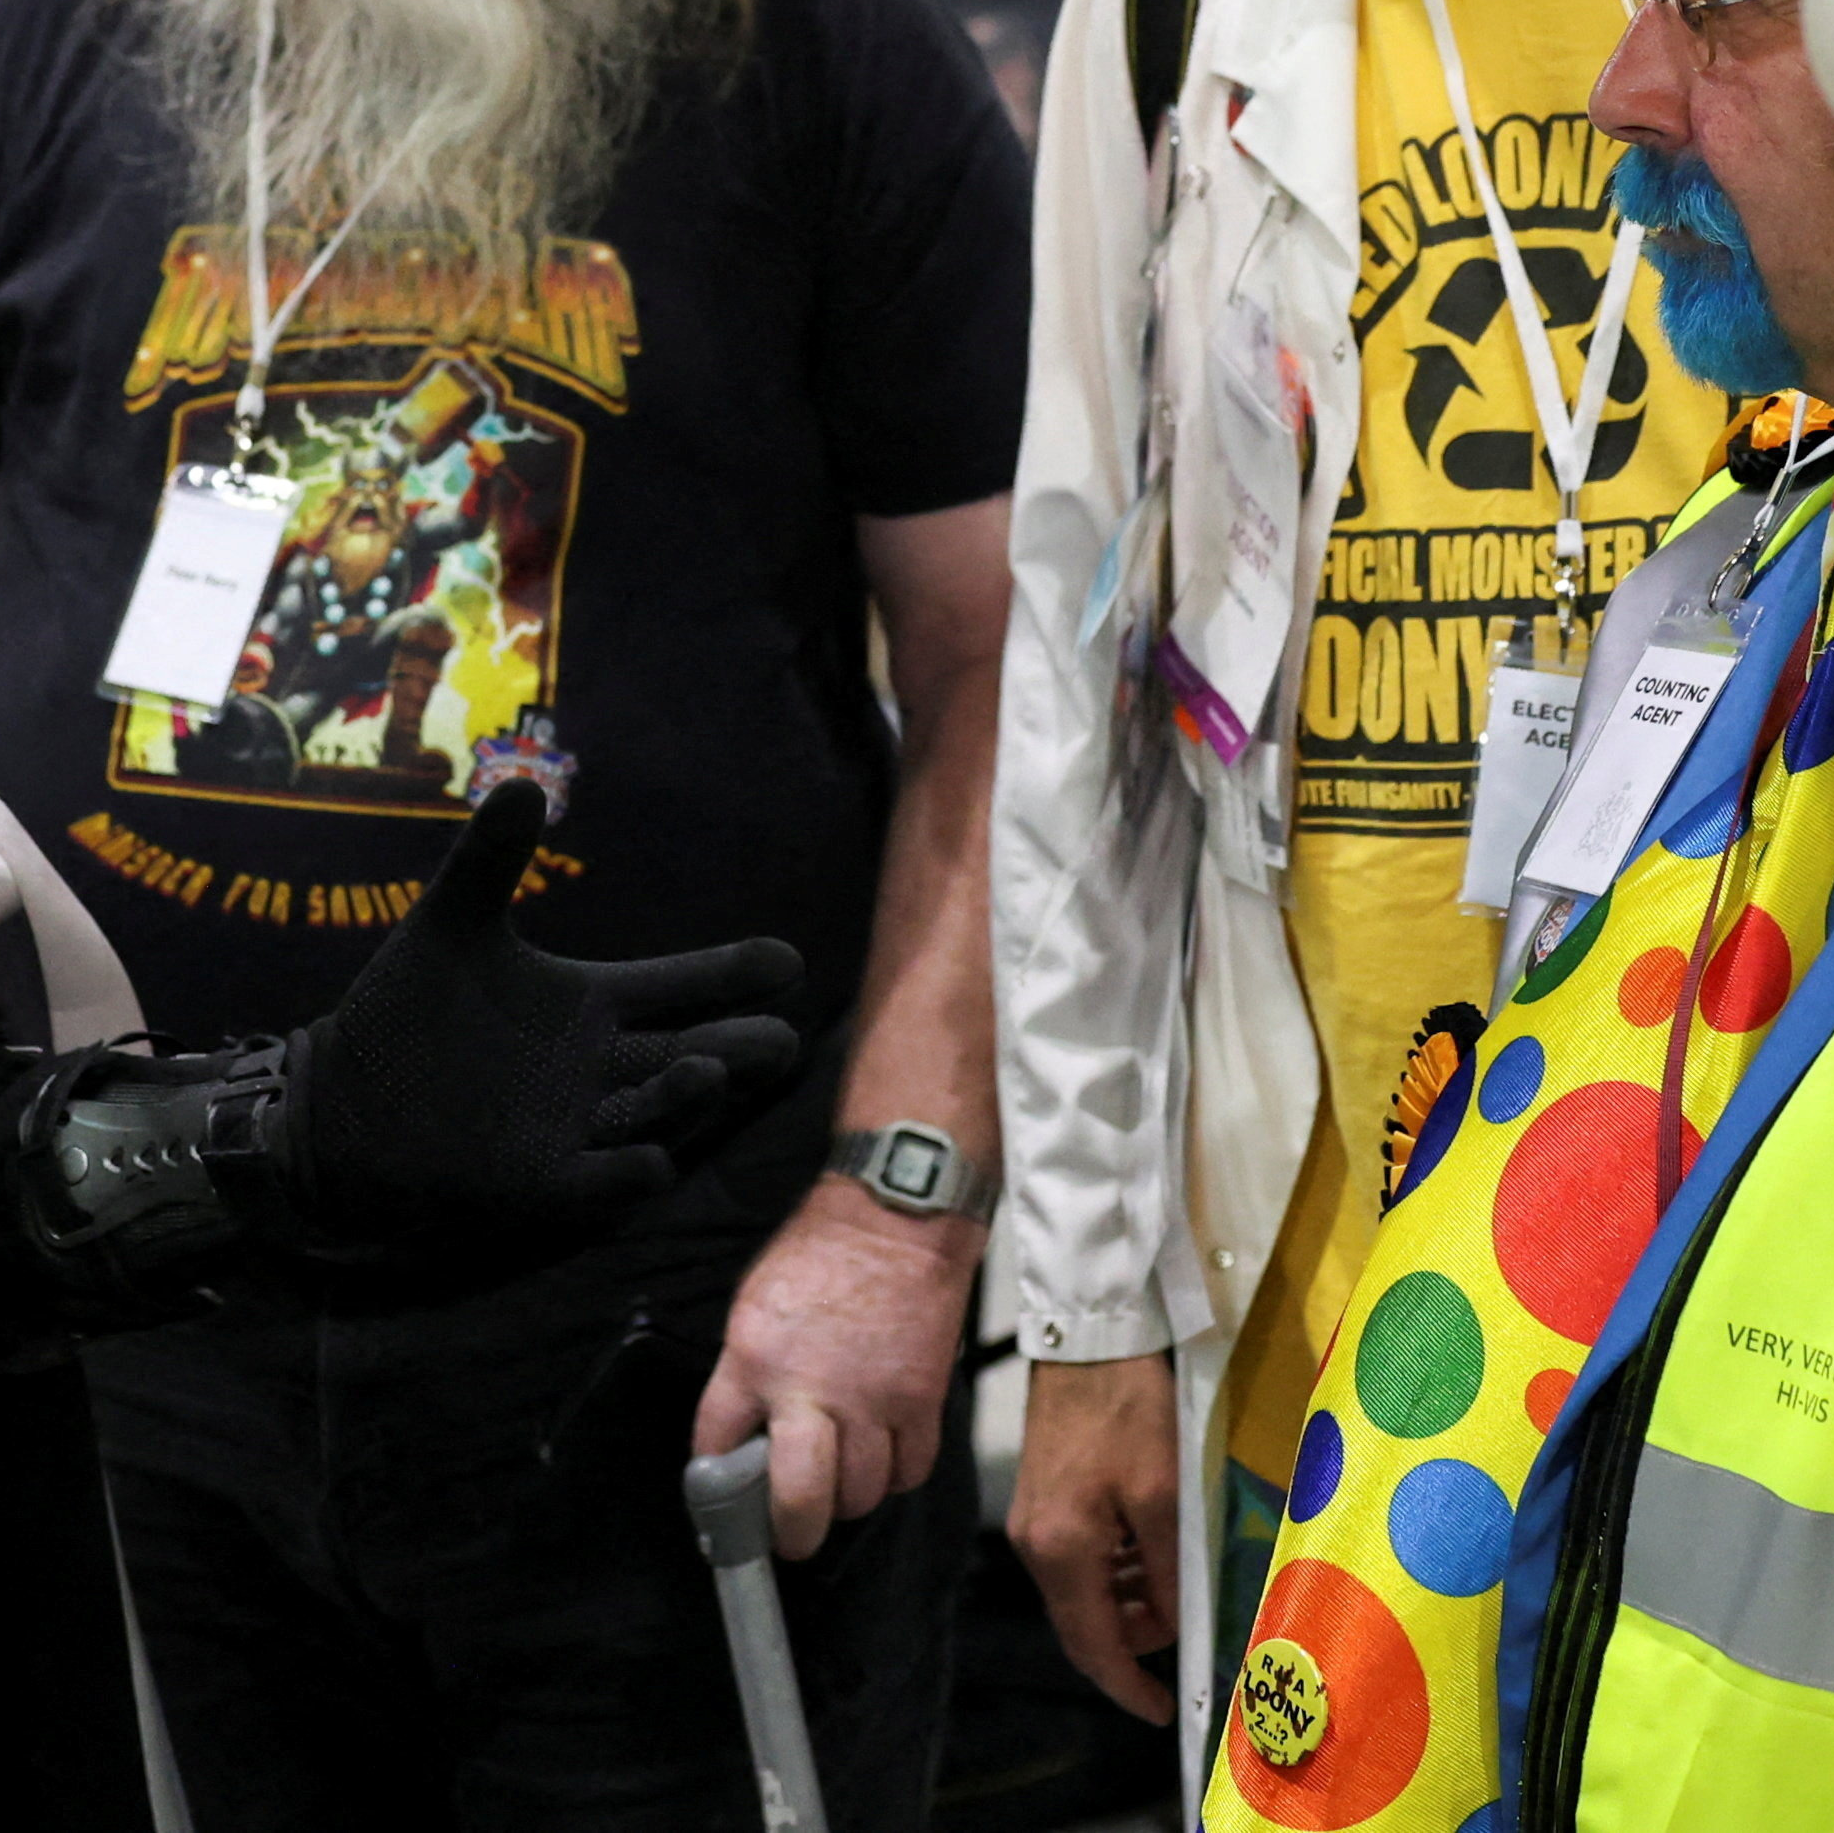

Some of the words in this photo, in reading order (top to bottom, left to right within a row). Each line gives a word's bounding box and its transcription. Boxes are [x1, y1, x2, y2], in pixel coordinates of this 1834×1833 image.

[1305, 614, 1516, 745] OONY
[1635, 676, 1710, 703] COUNTING
[1630, 704, 1683, 726] AGENT
[1524, 727, 1571, 750] AGE
[1727, 1322, 1794, 1367] VERY,
[1776, 1380, 1829, 1424] HI-VIS
[1262, 1653, 1274, 1675] R
[1292, 1678, 1304, 1698] A
[1243, 1670, 1316, 1733] LOONY
